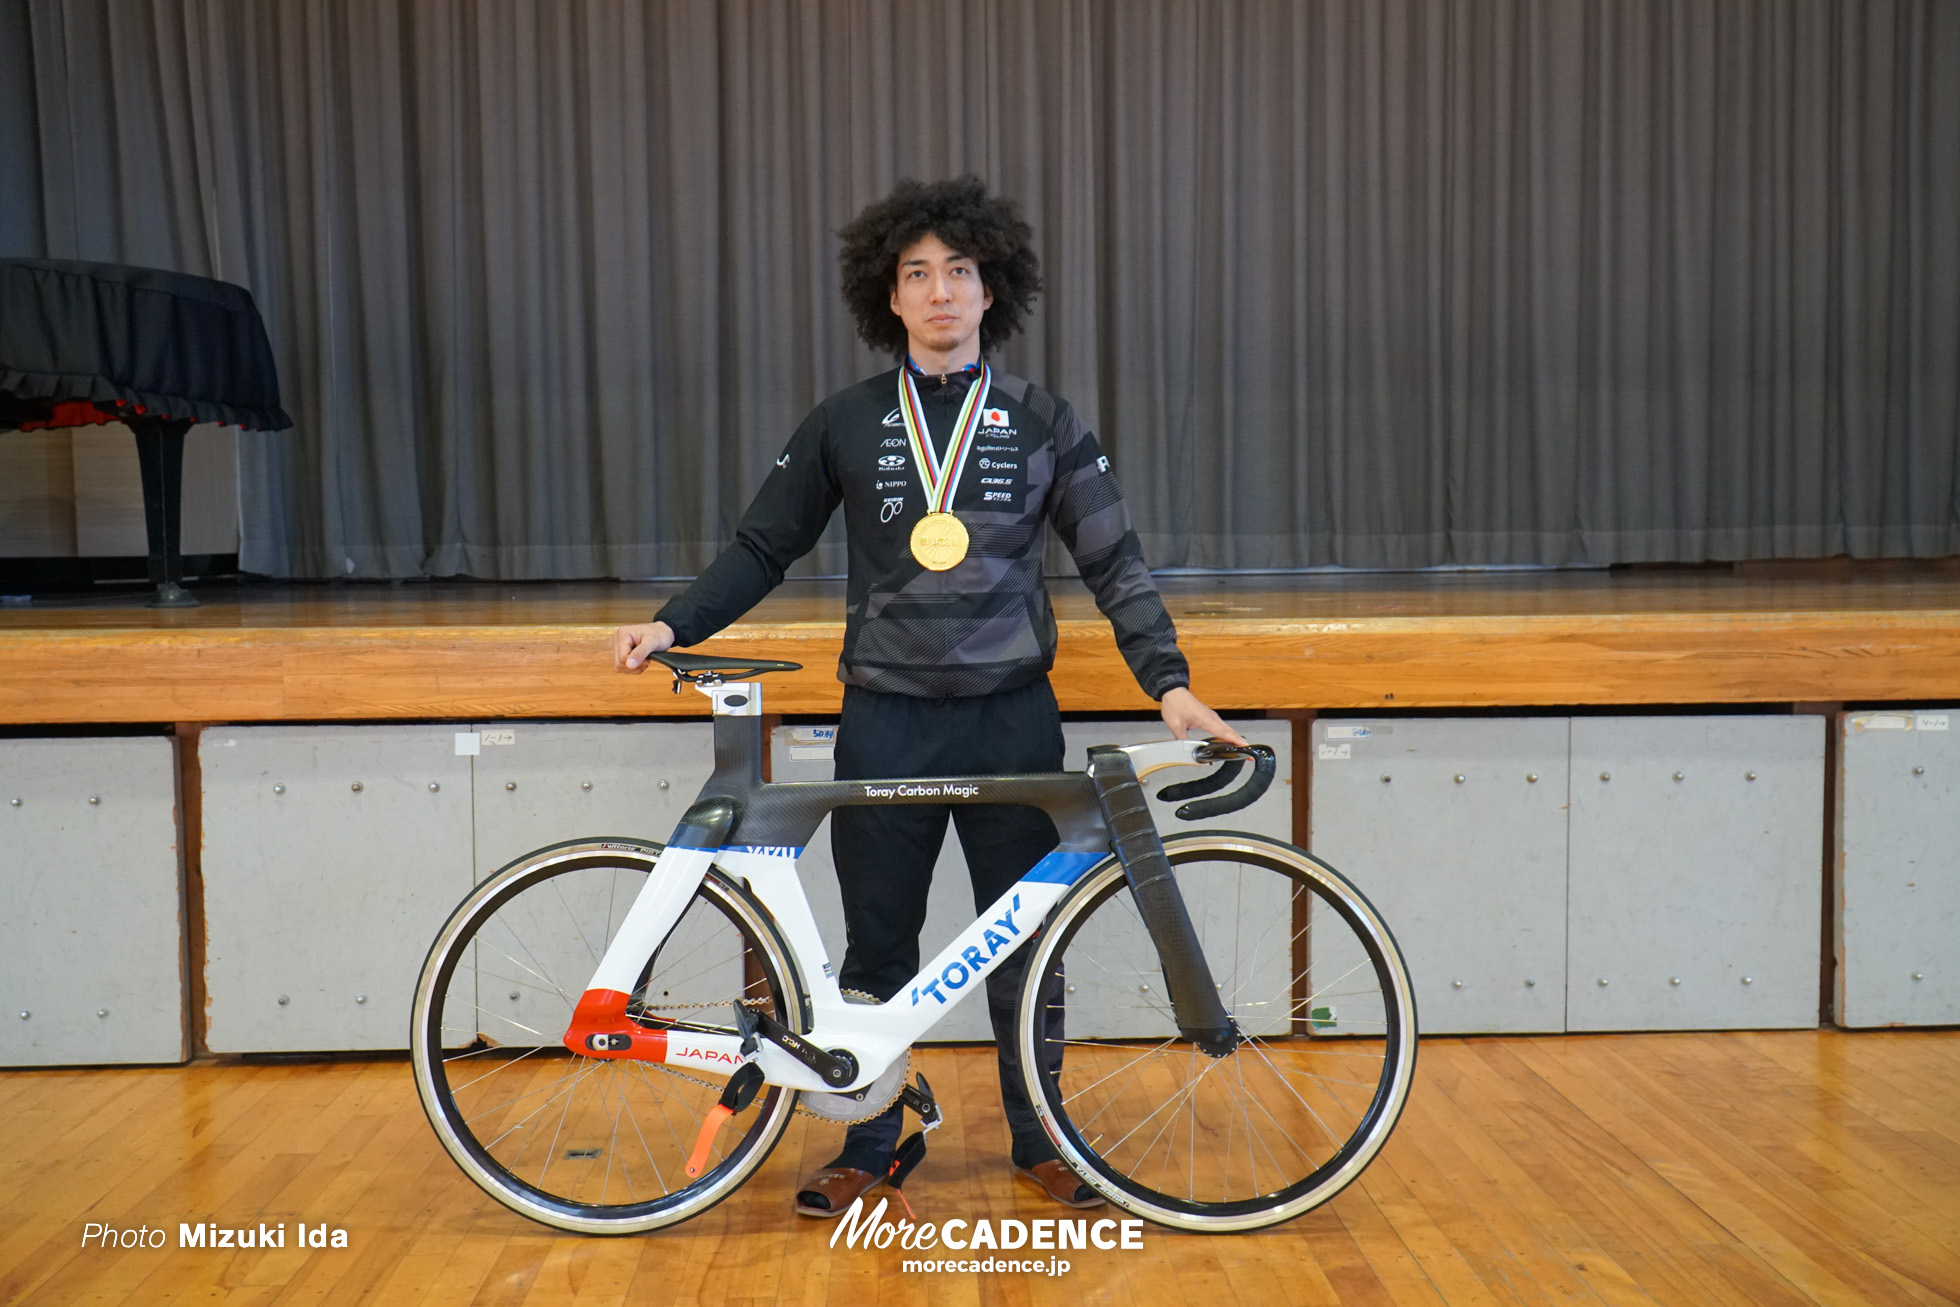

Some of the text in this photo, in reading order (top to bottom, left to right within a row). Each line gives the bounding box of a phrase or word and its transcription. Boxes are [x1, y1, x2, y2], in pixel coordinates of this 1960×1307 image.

[991, 461, 1018, 470] Cyclers
[884, 480, 907, 488] NIPPO
[983, 491, 1012, 501] SPEED
[864, 783, 979, 799] Toray Carbon Magic
